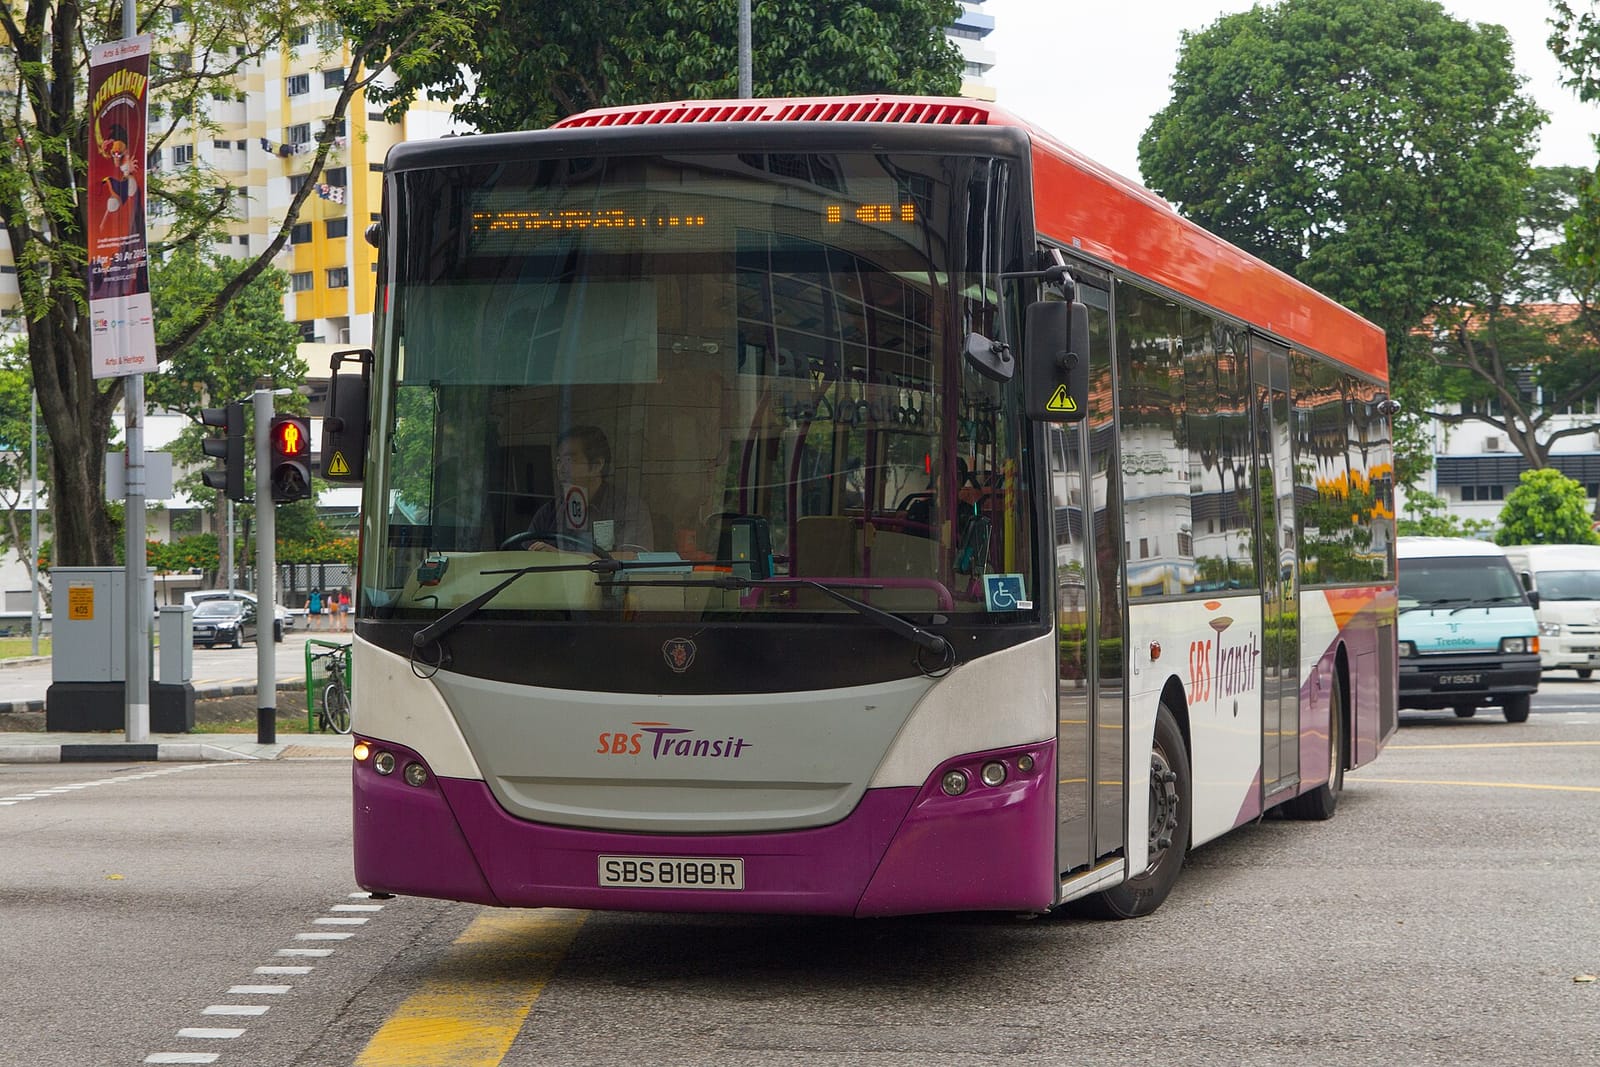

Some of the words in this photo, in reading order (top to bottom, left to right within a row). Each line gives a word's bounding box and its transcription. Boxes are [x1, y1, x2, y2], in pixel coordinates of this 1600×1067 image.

[1188, 639, 1212, 706] SBS
[1209, 616, 1260, 716] Transit
[597, 732, 644, 756] SBS
[640, 727, 753, 760] Transit
[605, 861, 736, 885] SBS8188R
